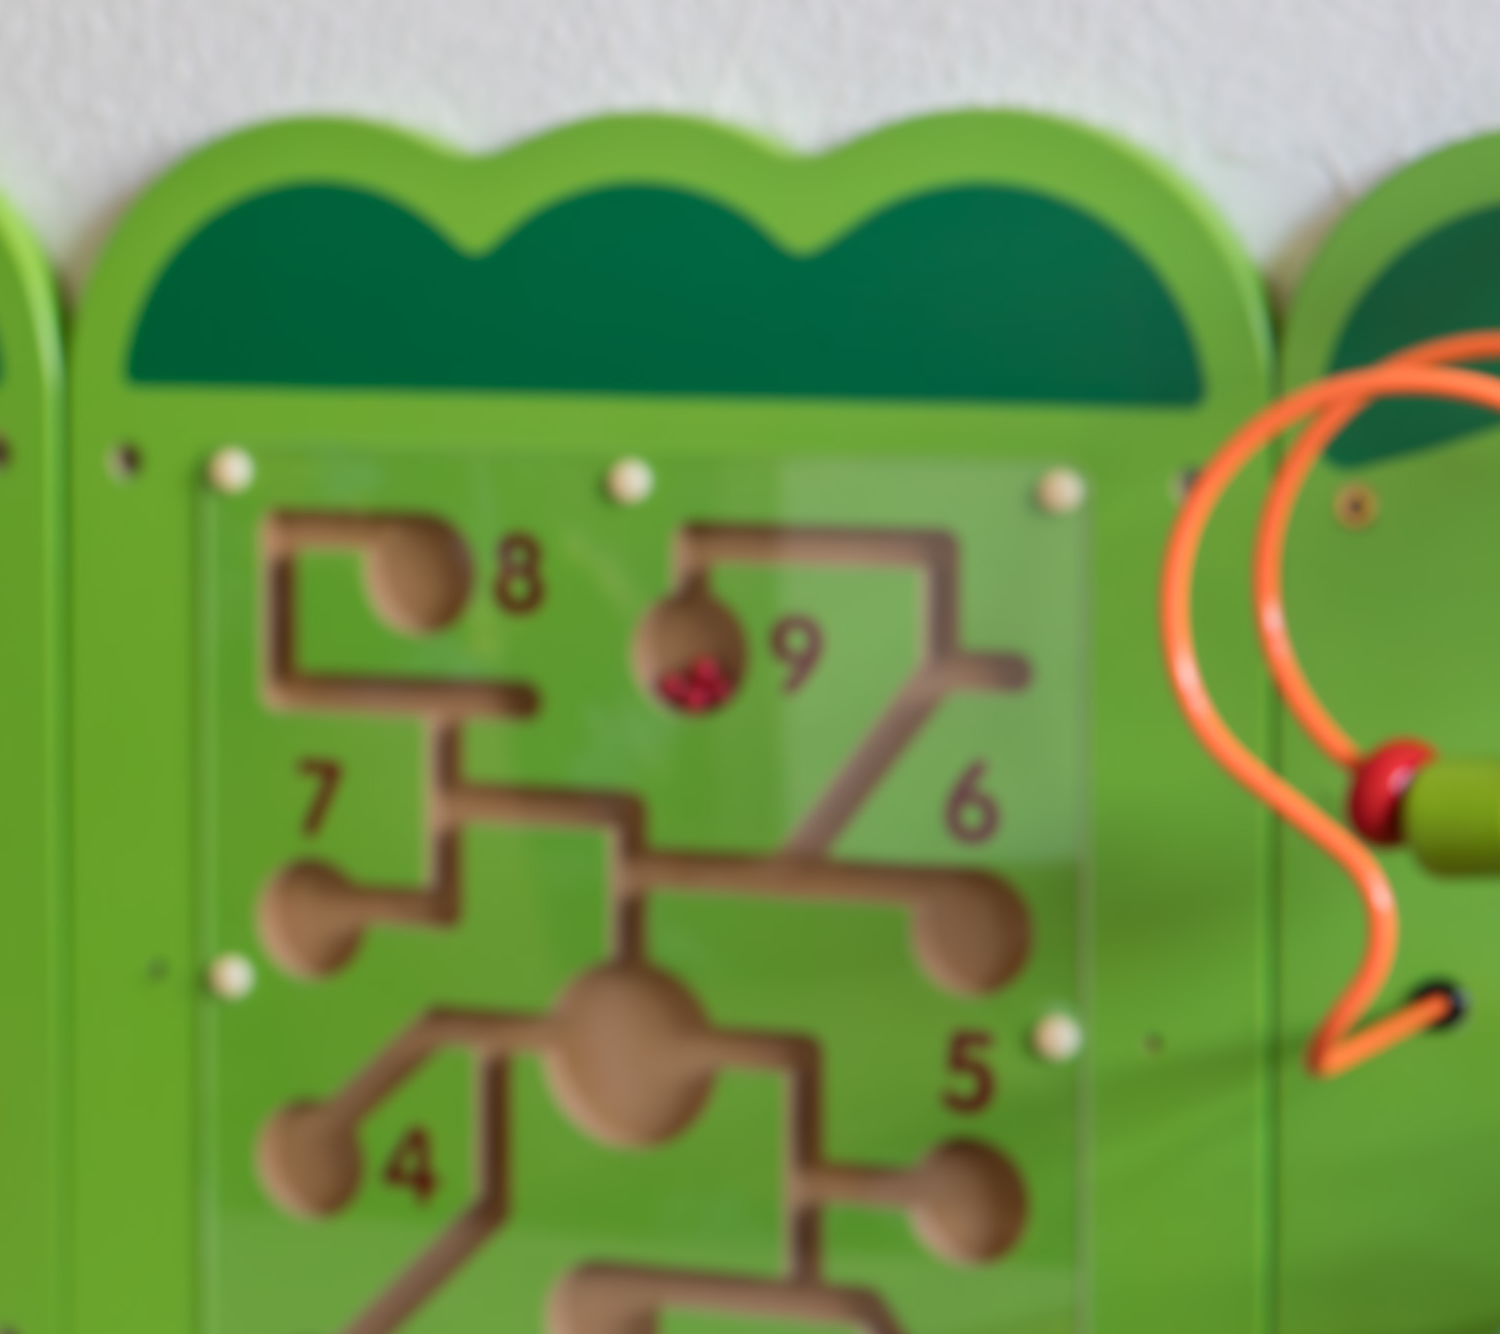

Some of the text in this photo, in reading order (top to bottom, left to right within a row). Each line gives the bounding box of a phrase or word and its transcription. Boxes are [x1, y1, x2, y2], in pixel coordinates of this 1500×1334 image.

[490, 530, 546, 617] 8
[768, 614, 824, 696] 9
[296, 757, 343, 837] 7
[945, 761, 1001, 845] 6
[941, 1031, 995, 1114] 5
[384, 1126, 438, 1204] 4
